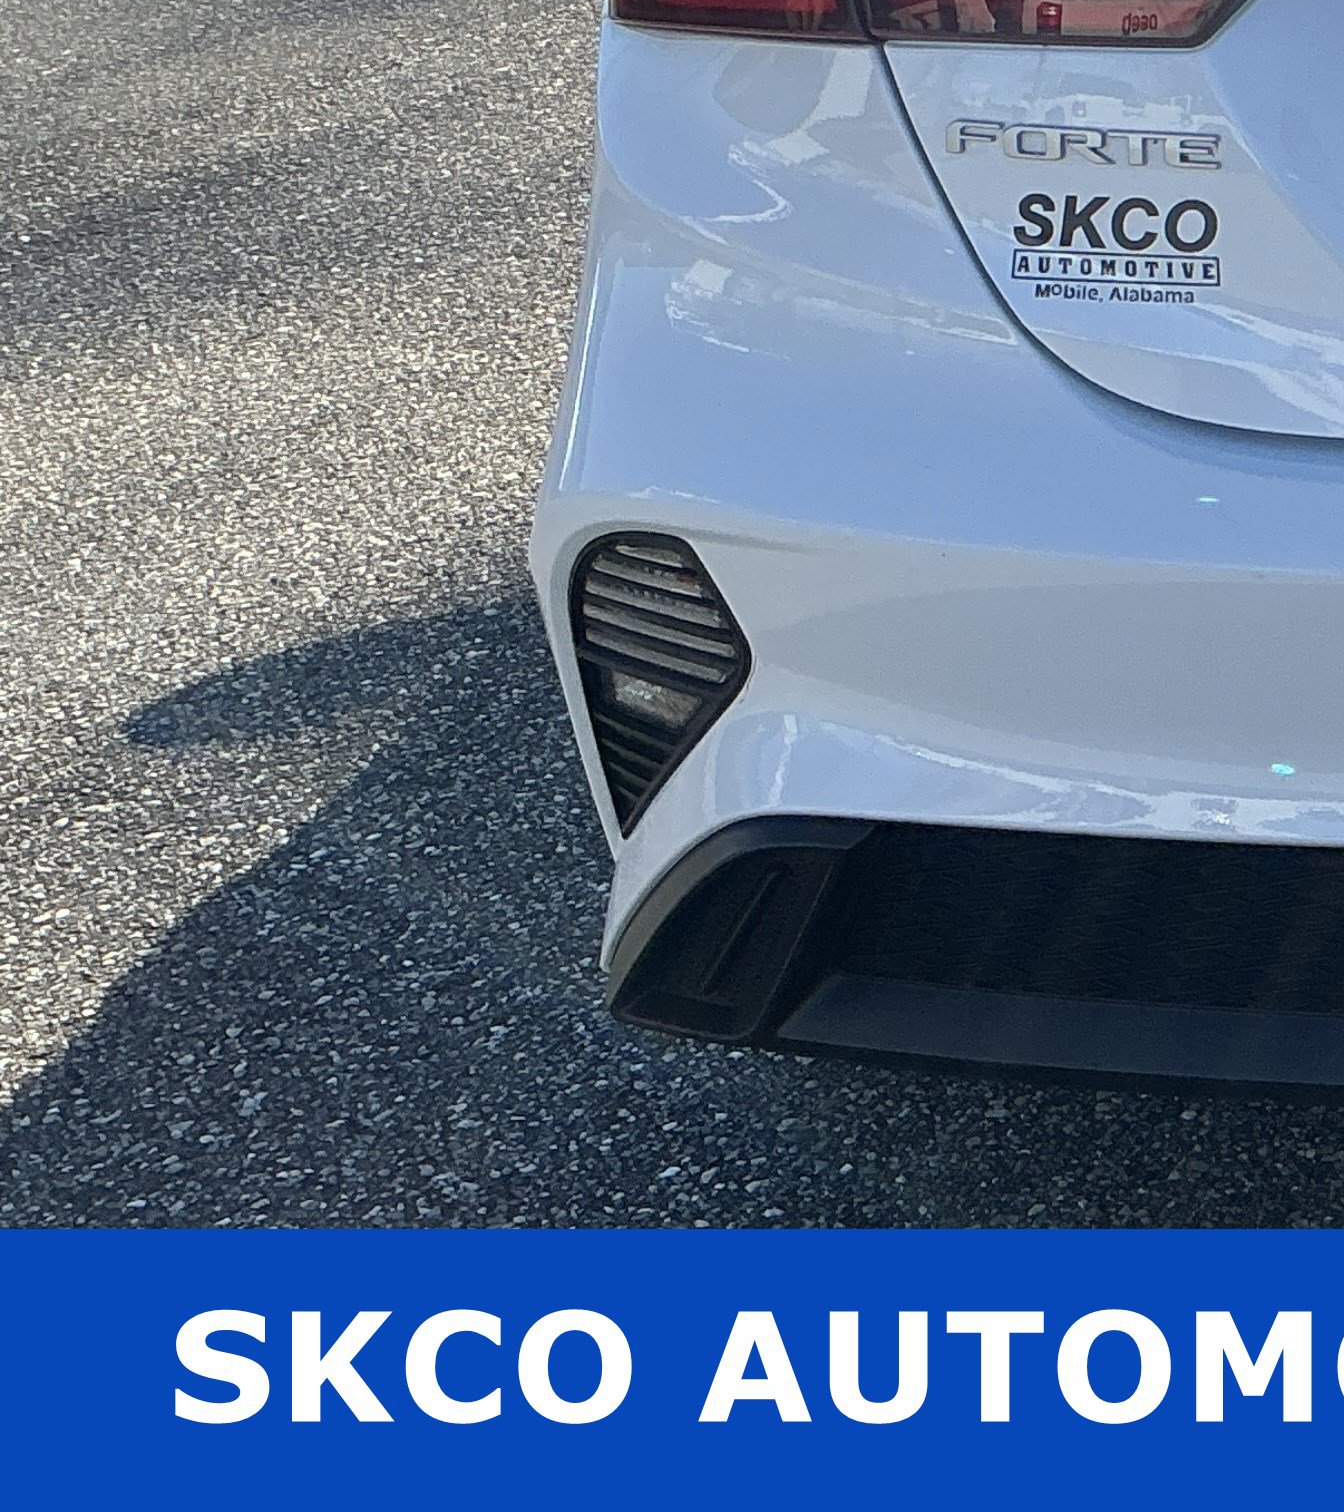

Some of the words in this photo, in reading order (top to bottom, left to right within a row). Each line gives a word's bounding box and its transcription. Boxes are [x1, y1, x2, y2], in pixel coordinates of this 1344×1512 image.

[945, 119, 1222, 170] FORTE
[1013, 193, 1218, 253] SKCO
[1016, 255, 1217, 280] AUTOMOTIVE
[1034, 283, 1104, 303] Mobile,
[1109, 287, 1196, 304] Alabama
